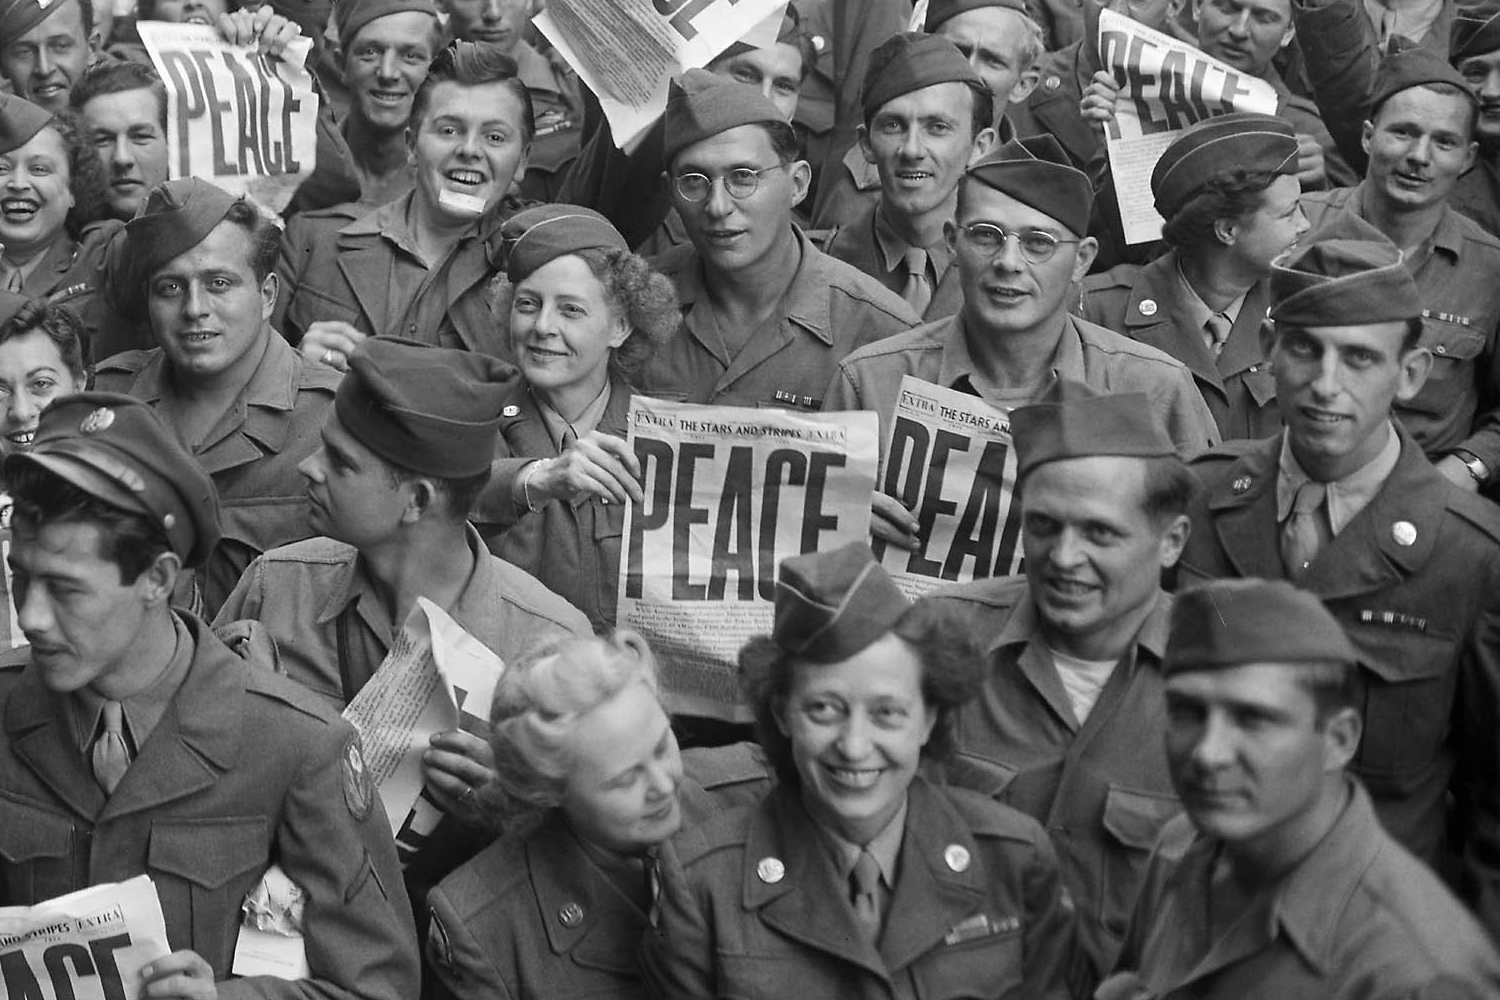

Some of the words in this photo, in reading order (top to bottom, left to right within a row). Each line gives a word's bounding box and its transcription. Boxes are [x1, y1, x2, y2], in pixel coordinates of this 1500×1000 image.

[159, 51, 300, 176] PEACE
[1101, 30, 1250, 140] PEACE
[680, 420, 698, 431] THE
[701, 422, 732, 435] STARS
[735, 424, 757, 436] AND
[760, 426, 802, 438] STRIPES
[940, 406, 957, 421] THE
[959, 412, 990, 429] STARS
[625, 436, 846, 601] PEACE
[25, 923, 70, 939] STRIPES
